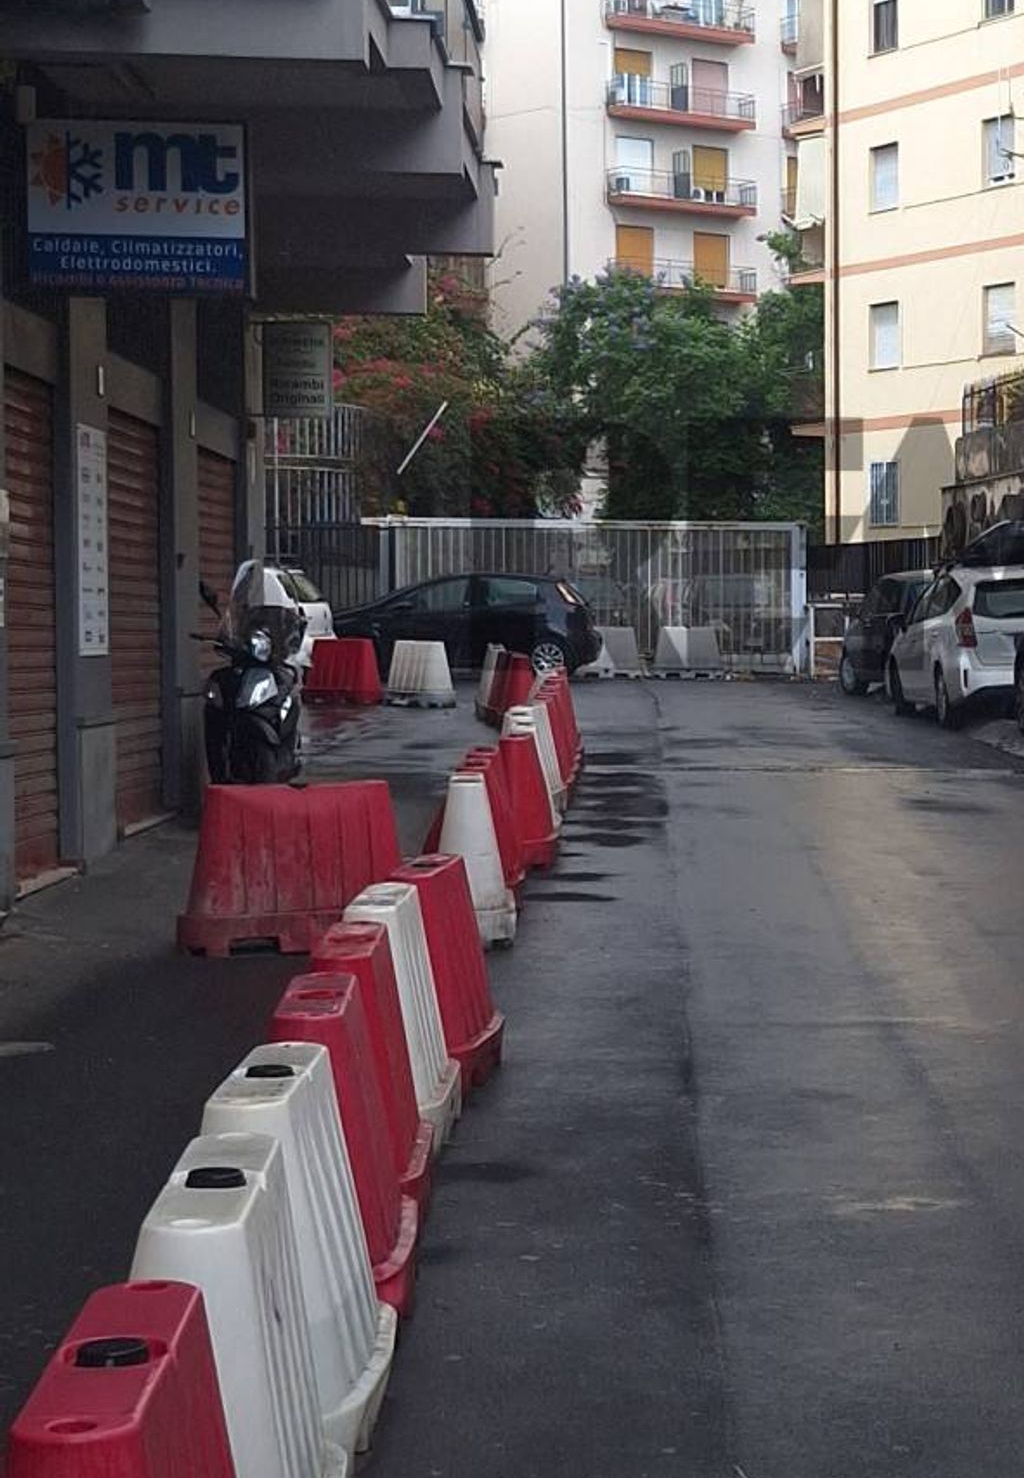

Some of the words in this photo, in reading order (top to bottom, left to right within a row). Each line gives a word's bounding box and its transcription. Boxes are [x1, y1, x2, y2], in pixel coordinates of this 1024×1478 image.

[114, 132, 239, 194] mt
[115, 196, 241, 215] service
[32, 238, 105, 255] Caldaie,
[110, 240, 244, 259] Climatizzatori,
